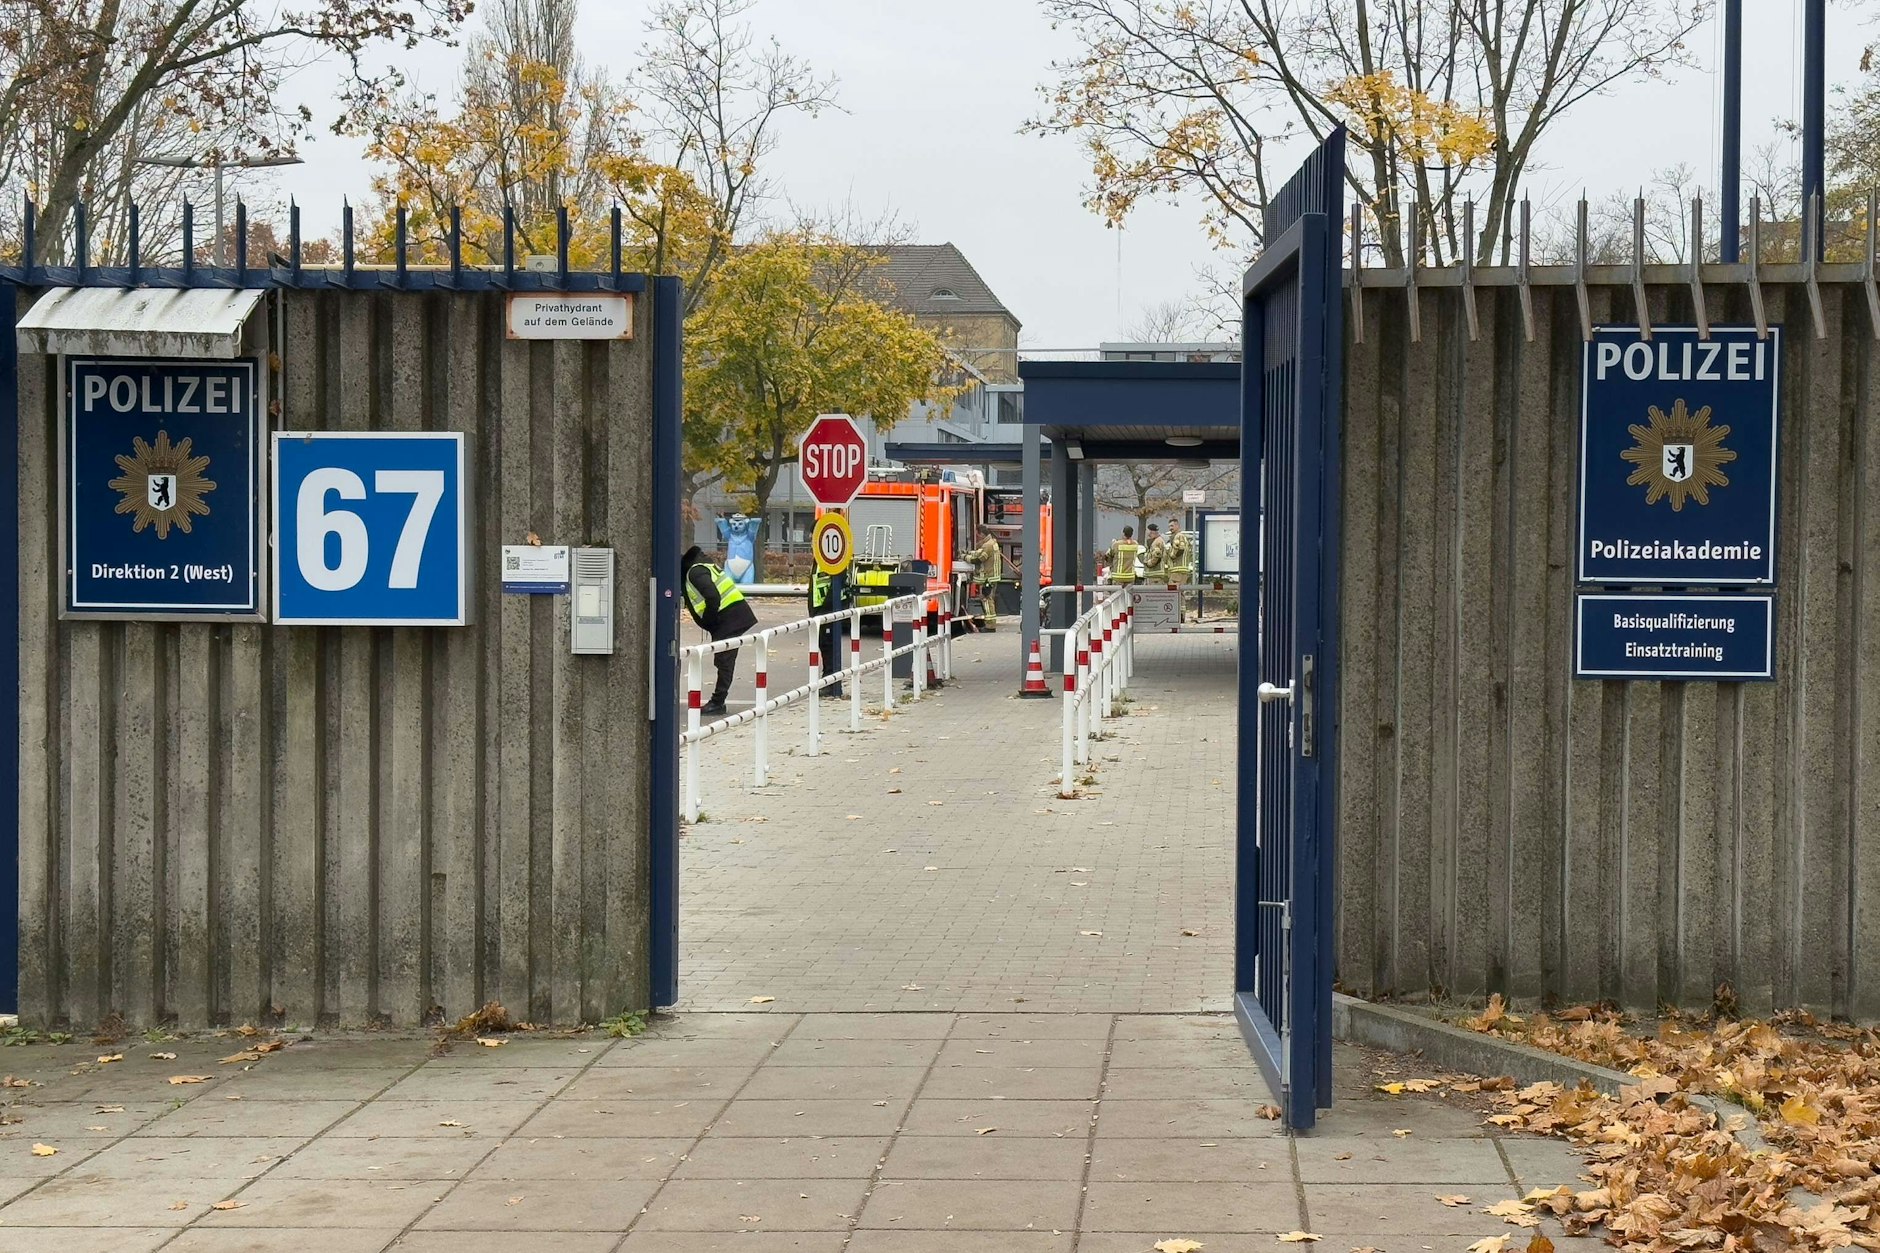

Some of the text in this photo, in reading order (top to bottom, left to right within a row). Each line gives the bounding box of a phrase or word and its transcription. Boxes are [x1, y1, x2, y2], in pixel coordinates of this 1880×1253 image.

[535, 303, 602, 315] Privathydrant
[524, 316, 614, 326] auf dem Gelände
[1596, 342, 1765, 381] POLIZEI
[84, 375, 241, 414] POLIZEI
[805, 444, 861, 479] STOP
[296, 467, 445, 591] 67
[825, 534, 840, 554] 10
[1591, 539, 1762, 560] Polizeiakademie
[91, 563, 234, 584] Direktion 2 (West)
[1613, 613, 1735, 634] Basisqualifizierung
[1625, 642, 1723, 662] Einsatztraining
